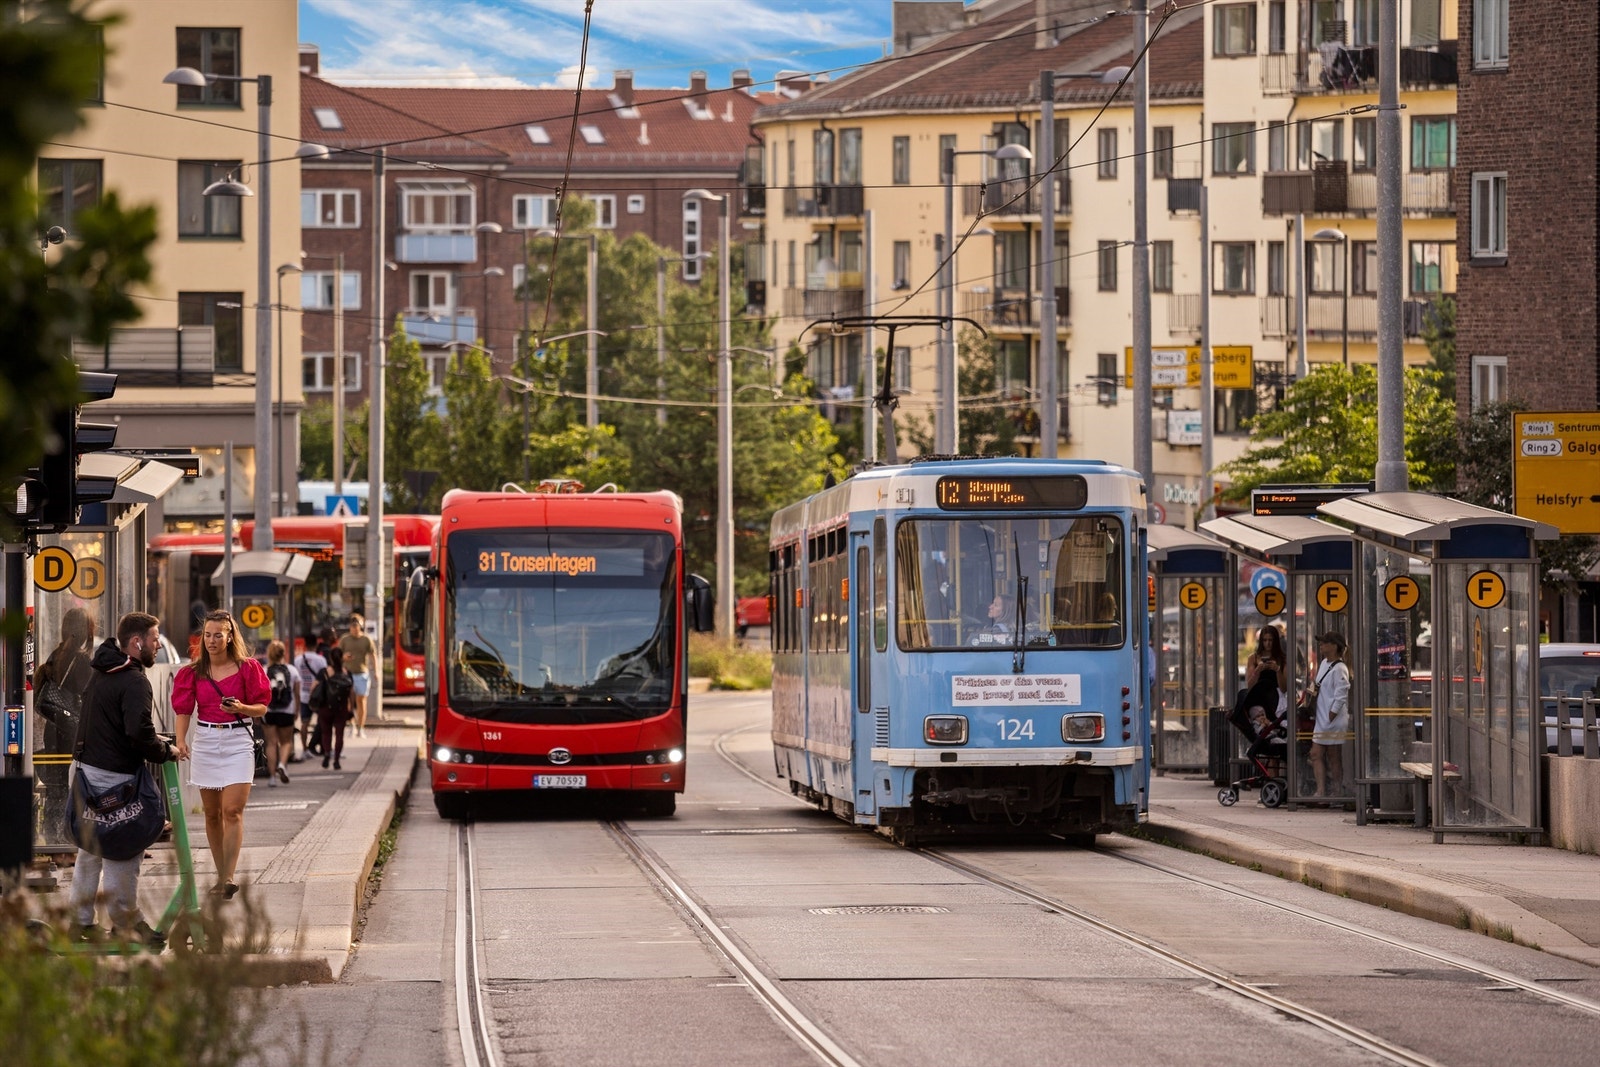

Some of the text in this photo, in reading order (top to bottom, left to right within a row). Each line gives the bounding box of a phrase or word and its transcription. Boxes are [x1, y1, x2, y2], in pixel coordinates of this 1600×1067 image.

[1156, 354, 1174, 363] Ring
[1157, 373, 1175, 382] Ring
[1528, 425, 1544, 434] Ring
[1527, 443, 1557, 454] Ring 2
[1536, 493, 1584, 507] Helsfyr
[44, 556, 64, 582] D
[479, 551, 597, 576] 31 Tonsenhagen
[80, 567, 98, 590] D
[1188, 588, 1199, 604] E
[1326, 587, 1339, 605] F
[1395, 583, 1410, 604] F
[1479, 578, 1494, 600] F
[1264, 592, 1276, 610] F
[248, 610, 259, 623] C
[483, 732, 502, 741] 1361
[996, 718, 1036, 741] 124
[541, 776, 584, 786] EV 70592
[169, 786, 181, 806] Bolt
